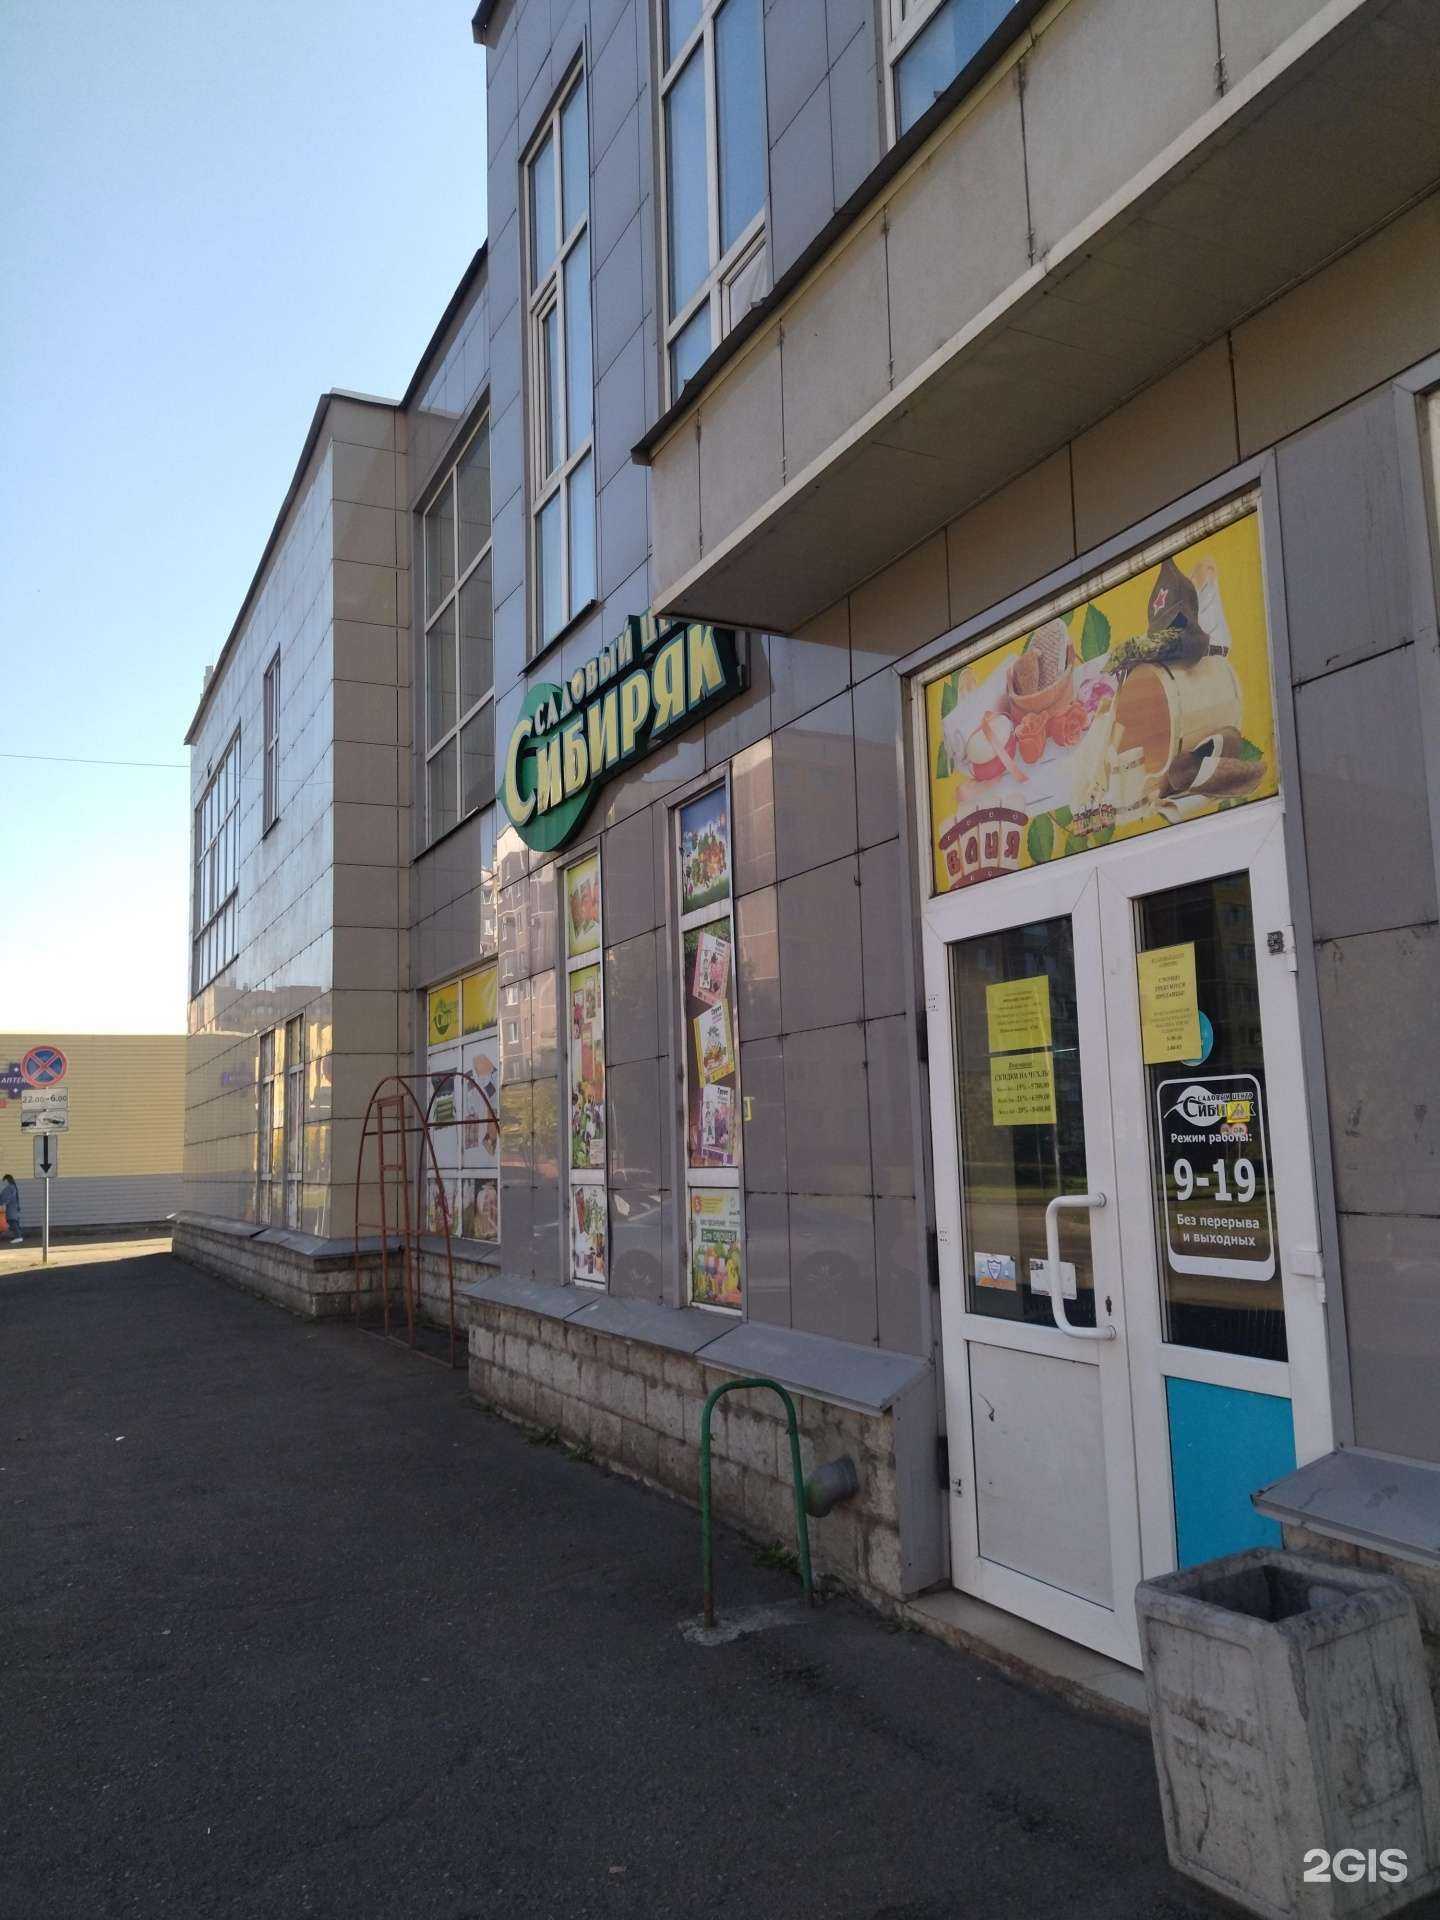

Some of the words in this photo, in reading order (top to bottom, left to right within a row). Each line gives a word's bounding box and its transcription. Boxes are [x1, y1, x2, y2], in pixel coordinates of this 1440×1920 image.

[532, 617, 633, 735] САДОВЫЙ
[504, 624, 727, 827] СИБИРЯК
[1, 1077, 26, 1085] АПТЕК
[1171, 1132, 1206, 1144] Режим
[1209, 1133, 1253, 1145] работы:
[1173, 1158, 1256, 1203] 9-19
[1176, 1212, 1196, 1226] Без
[1199, 1215, 1260, 1230] перерыва
[1183, 1233, 1190, 1243] и
[1193, 1233, 1257, 1247] выходных
